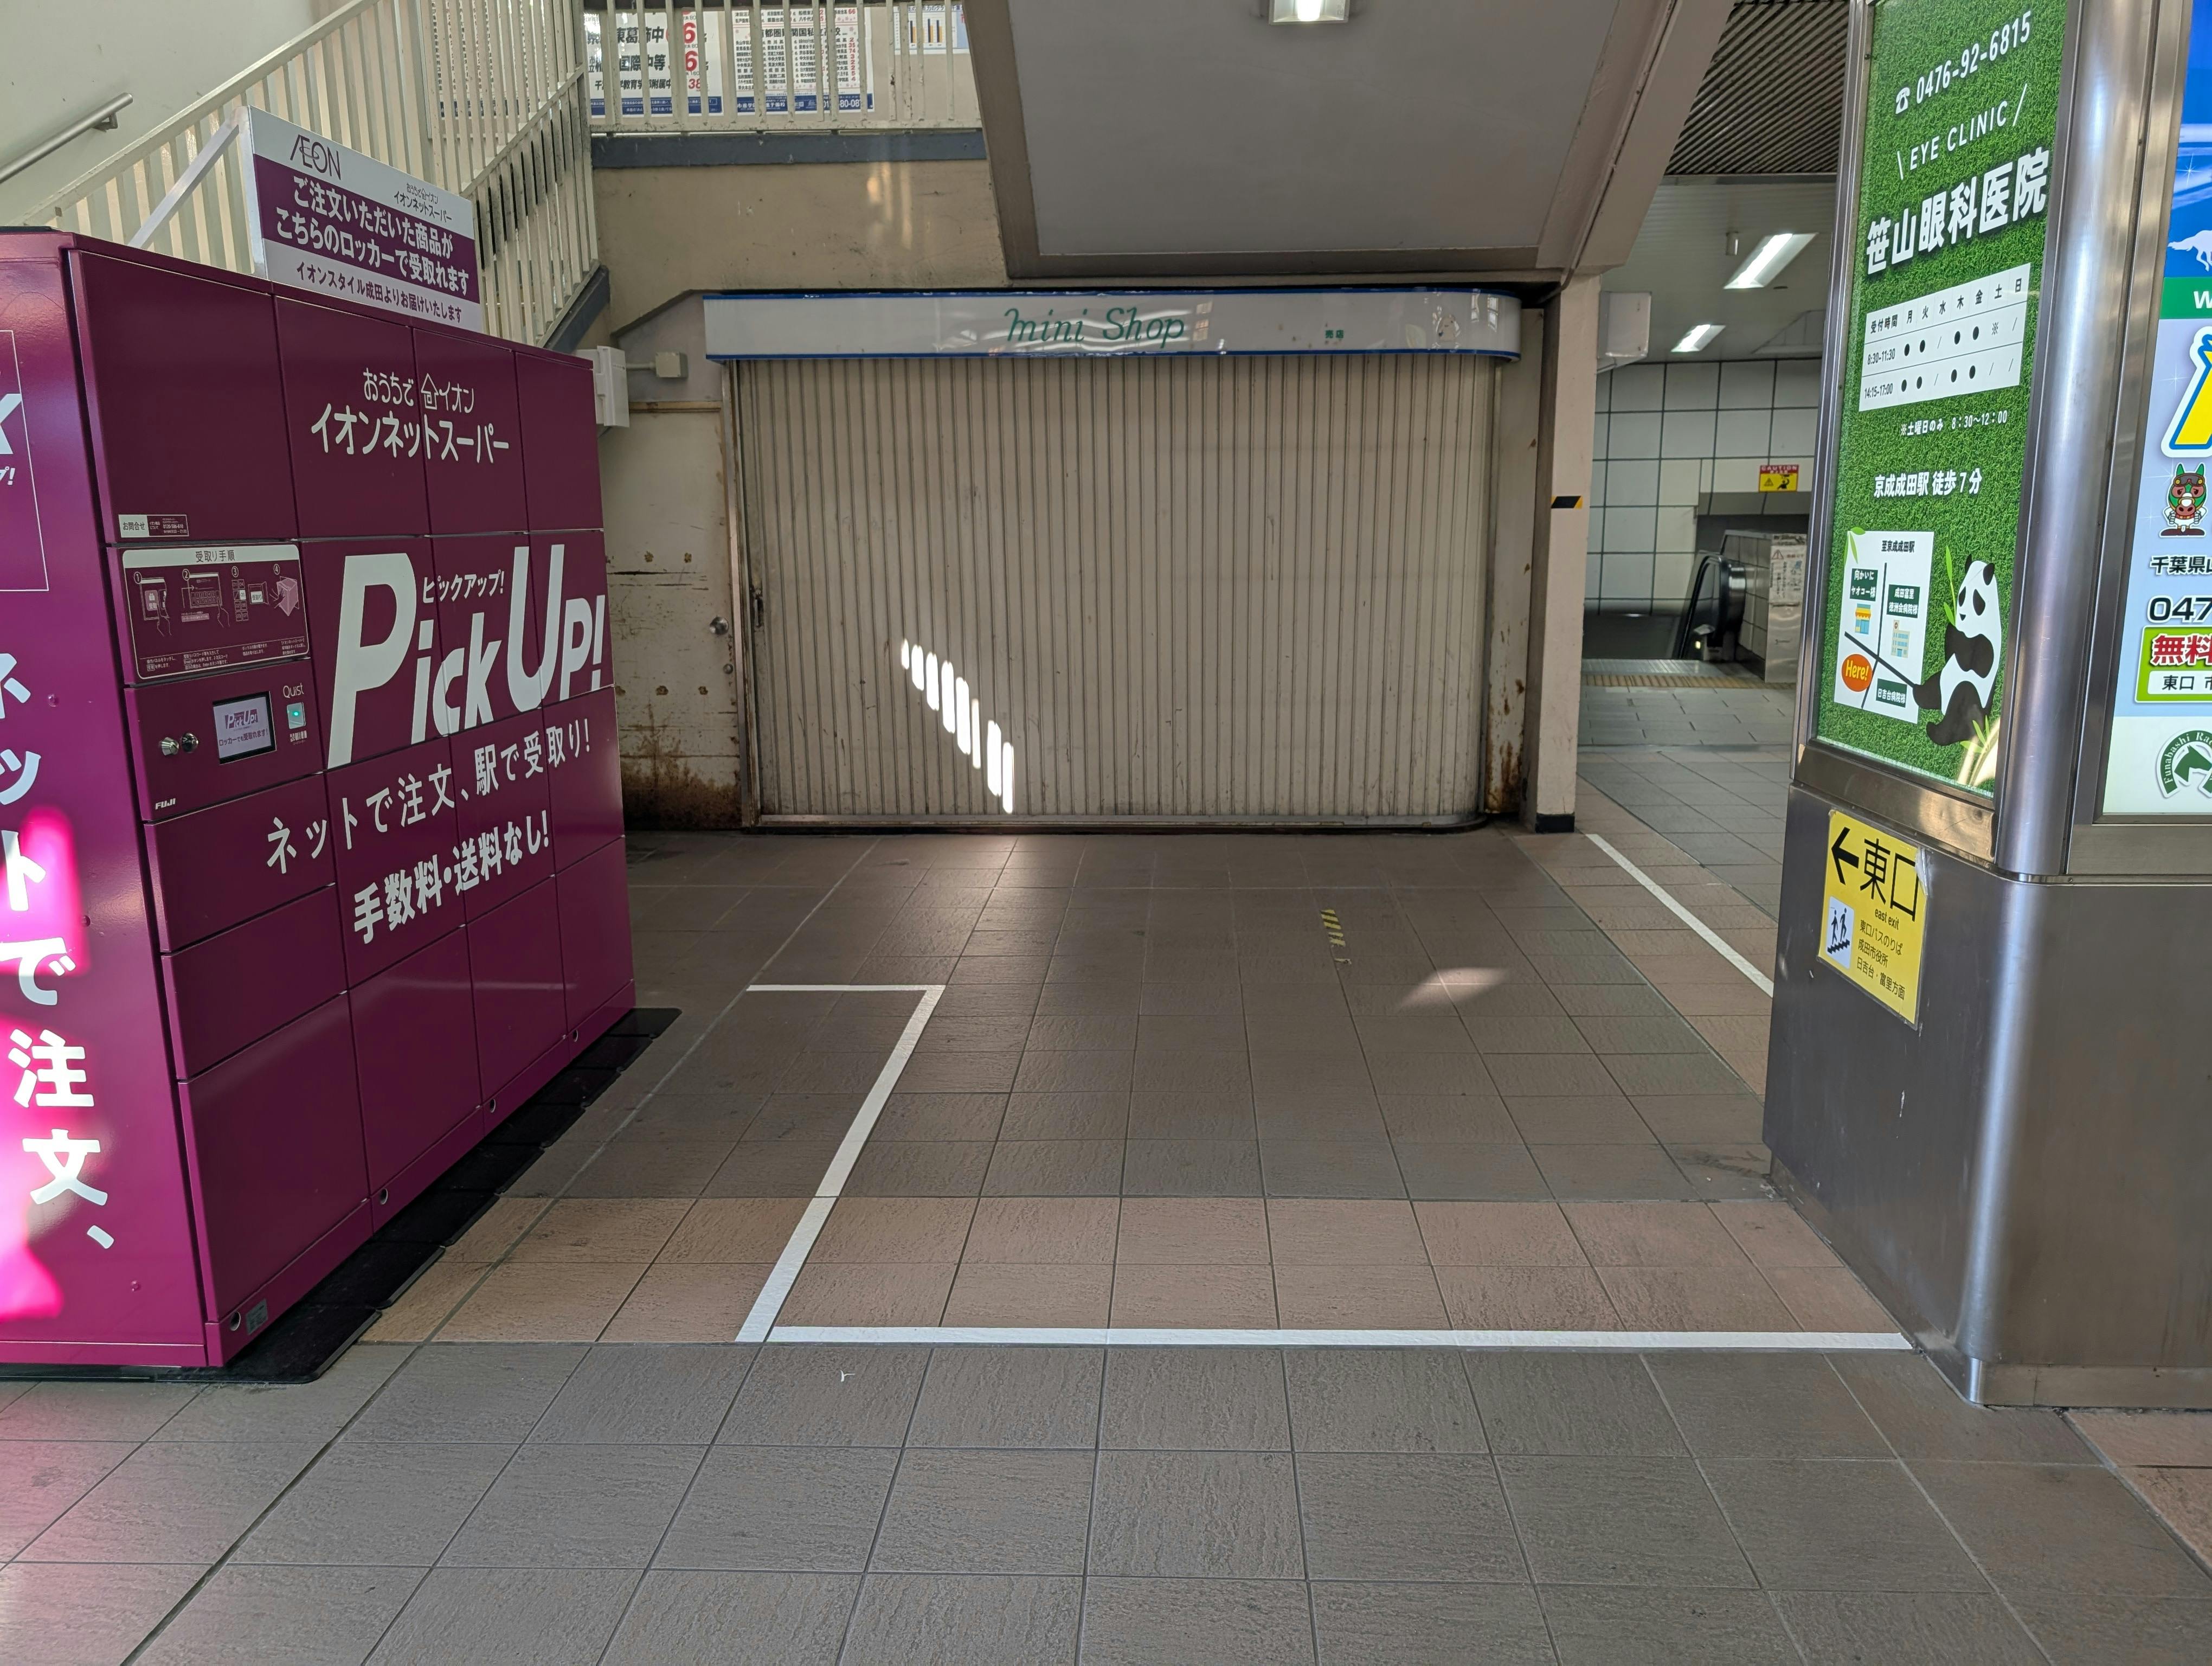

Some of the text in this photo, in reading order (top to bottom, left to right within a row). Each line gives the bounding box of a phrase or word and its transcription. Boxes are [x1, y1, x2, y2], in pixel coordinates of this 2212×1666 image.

[1917, 11, 2031, 104] 0476-92-6815
[1910, 101, 2008, 170] EYE CLINIC
[293, 175, 453, 259] ご注文いただいた商品が
[394, 190, 452, 223] イオンネットスーパー
[1866, 147, 2049, 275] 笹山眼科医院
[275, 206, 470, 297] こちらのロッカーで受取れます
[296, 261, 462, 323] イオンスタイル成田よりお届けいたします
[1870, 278, 2022, 335] 受付時間 月 火 水 木 金 土 日
[1103, 306, 1185, 349] Shop
[1867, 348, 1895, 365] 8:30-11:30
[1864, 383, 1893, 400] 14:15-17:00
[311, 403, 509, 464] イオンネットスーパー
[1874, 471, 1928, 498] 京成成田駅
[123, 522, 145, 530] お問合せ
[195, 549, 236, 562] 受取り手順
[1881, 540, 1915, 553] 至京成成田駅
[423, 570, 505, 604] ピックアップ!
[2152, 635, 2212, 664] 無料
[1846, 660, 1869, 681] Here!
[2162, 675, 2195, 690] 東口
[283, 683, 304, 699] Quist
[2164, 734, 2190, 784] Funabashi
[155, 798, 176, 810] FUJI
[353, 810, 549, 944] 手数料・送料なし!
[1860, 838, 1919, 922] 東口
[1875, 908, 1899, 930] east exit
[1858, 939, 1888, 968] 成田市役所
[1860, 919, 1903, 956] 東口バスのりば
[1857, 957, 1906, 1001] 日吉台・富里方面
